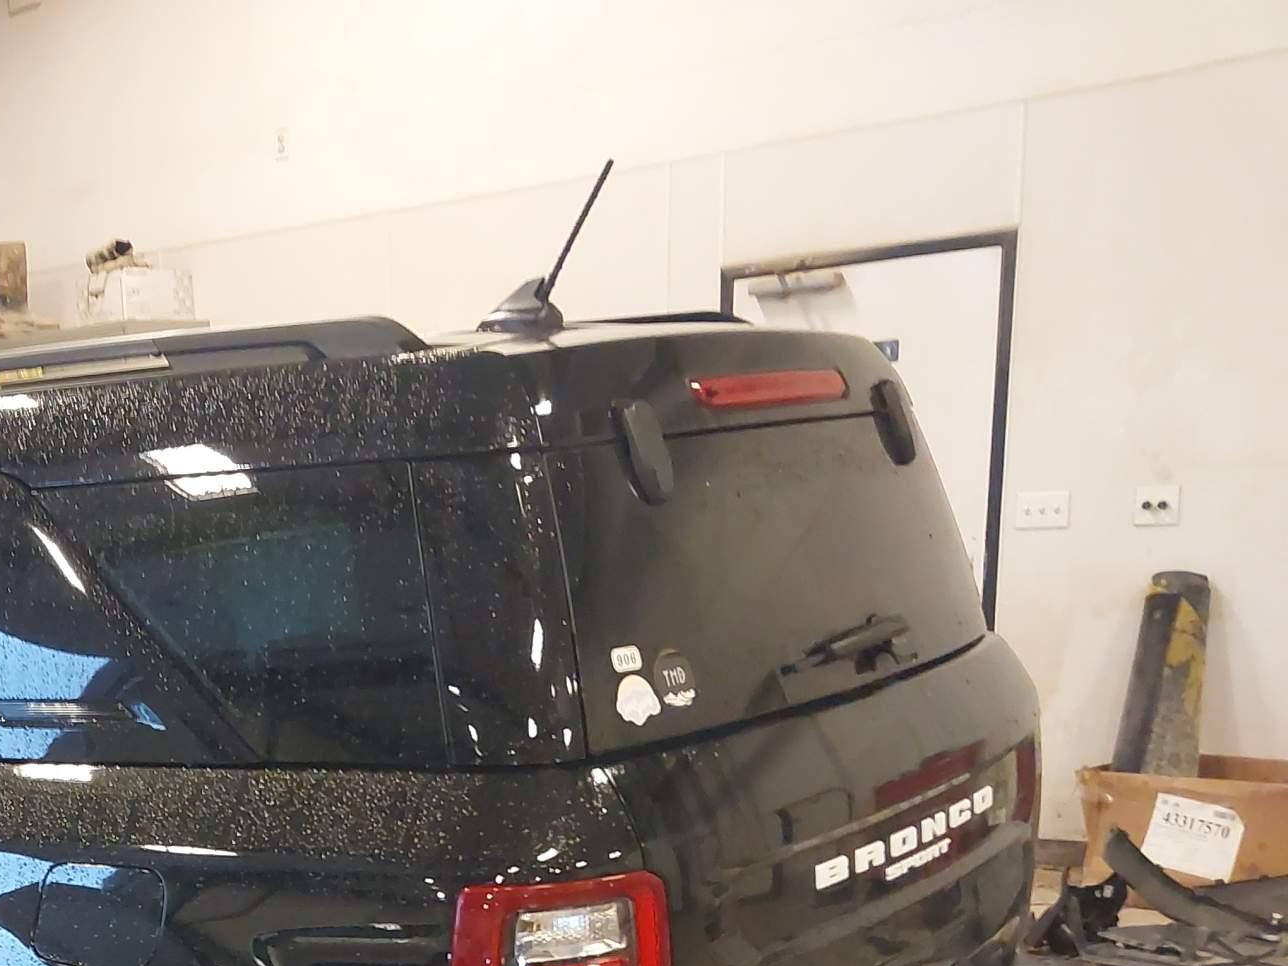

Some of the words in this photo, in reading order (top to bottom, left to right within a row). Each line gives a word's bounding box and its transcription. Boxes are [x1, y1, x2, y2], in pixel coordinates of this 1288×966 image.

[814, 784, 994, 891] BRONCO
[1161, 810, 1232, 840] 43317570
[884, 837, 952, 881] SPORT
